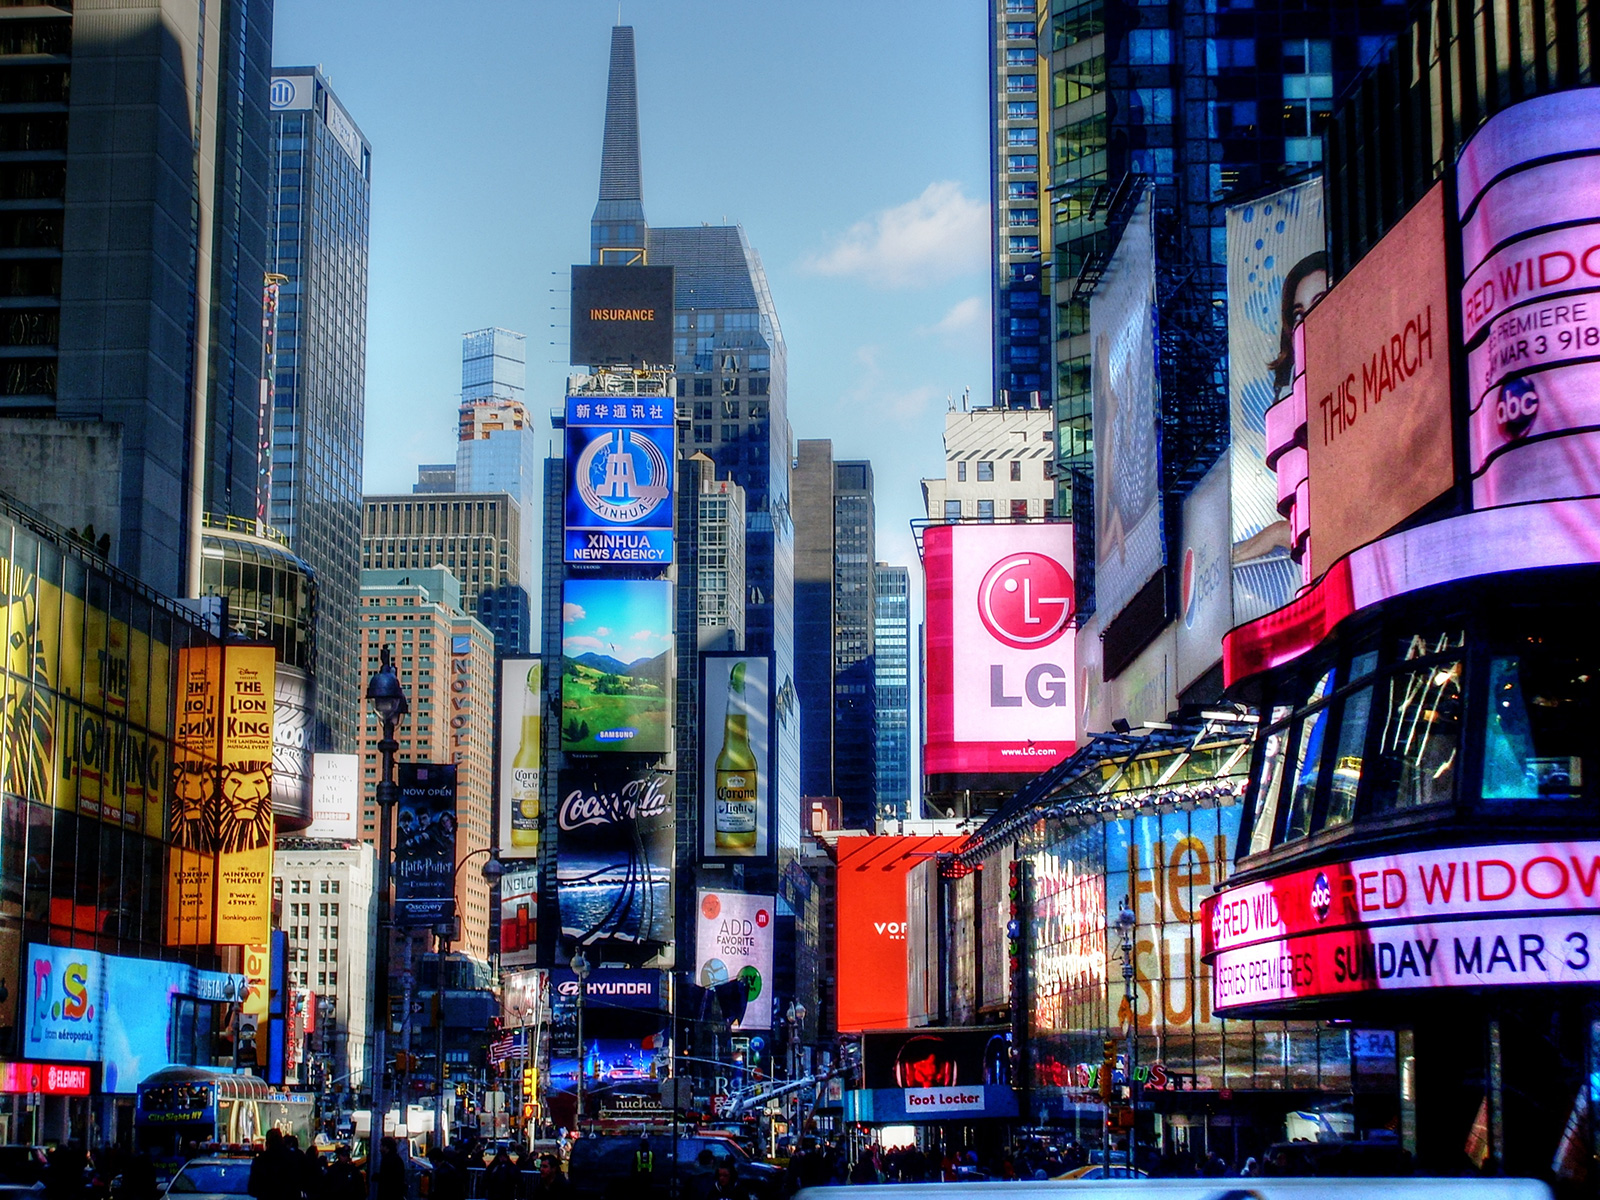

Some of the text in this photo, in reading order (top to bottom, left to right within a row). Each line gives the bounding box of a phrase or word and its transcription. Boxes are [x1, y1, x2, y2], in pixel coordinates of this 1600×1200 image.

[590, 309, 654, 320] INSURANCE
[1466, 281, 1495, 334] RED
[1498, 303, 1588, 341] PREMIERE
[1500, 340, 1529, 366] MAR
[1535, 335, 1548, 355] 3
[1319, 305, 1432, 446] THIS MARCH
[576, 404, 664, 419] 新华通讯社
[1496, 390, 1538, 424] abc
[596, 503, 648, 519] XINHUA
[588, 534, 651, 548] XINHUA
[573, 549, 665, 560] NEWS AGENCY
[235, 681, 262, 693] THE
[990, 663, 1067, 708] LG
[230, 695, 266, 714] LION
[452, 658, 467, 764] NOVOTE
[227, 716, 270, 738] KING
[274, 723, 311, 750] KOOK
[1001, 748, 1057, 756] www.LG.com
[515, 769, 538, 782] Coro
[717, 786, 755, 802] Corona
[725, 802, 748, 815] Light
[400, 857, 453, 878] Harry Potter
[1311, 887, 1331, 907] abc
[1340, 868, 1408, 914] RED
[719, 919, 753, 935] ADD
[1223, 898, 1250, 939] RED
[717, 936, 754, 946] FAVORITE
[721, 945, 749, 955] ICONS!
[1335, 931, 1590, 982] SUNDAY MAR 3
[1219, 952, 1312, 998] SERIES PREMIERES
[198, 977, 227, 1000] POSTAL
[586, 983, 651, 994] HYUNDAI
[32, 960, 94, 1042] p.s.
[57, 1071, 86, 1088] ELEMENT
[616, 1098, 663, 1109] nuchas
[909, 1093, 979, 1105] Foot Locker
